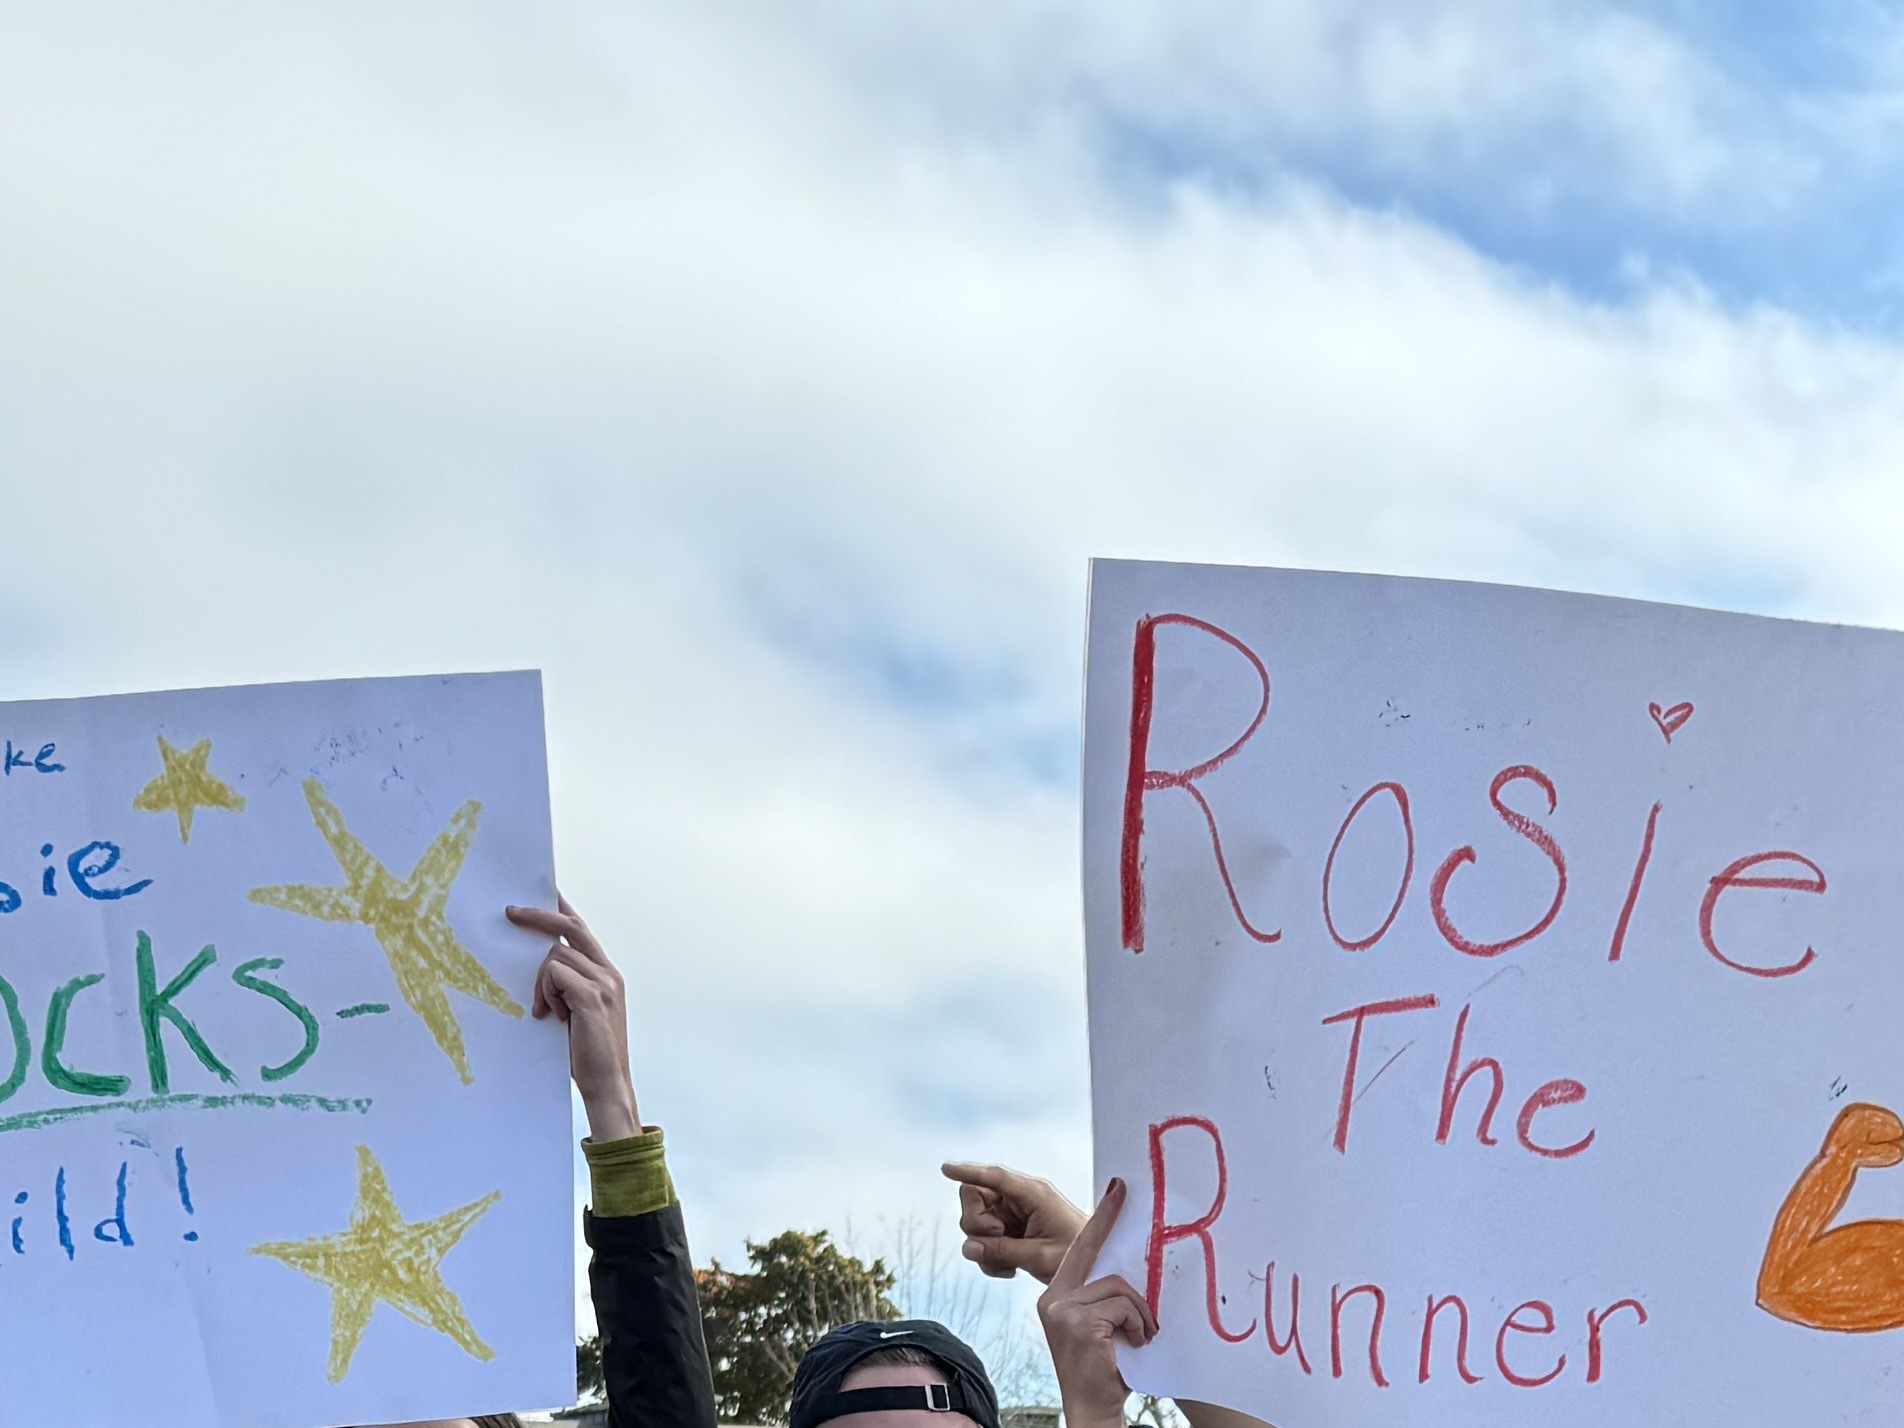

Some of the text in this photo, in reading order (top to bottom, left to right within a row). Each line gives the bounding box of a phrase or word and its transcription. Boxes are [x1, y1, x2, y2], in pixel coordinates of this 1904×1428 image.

[1121, 613, 1827, 978] Rosie
[1321, 994, 1597, 1159] The
[1145, 1113, 1648, 1389] Runner
